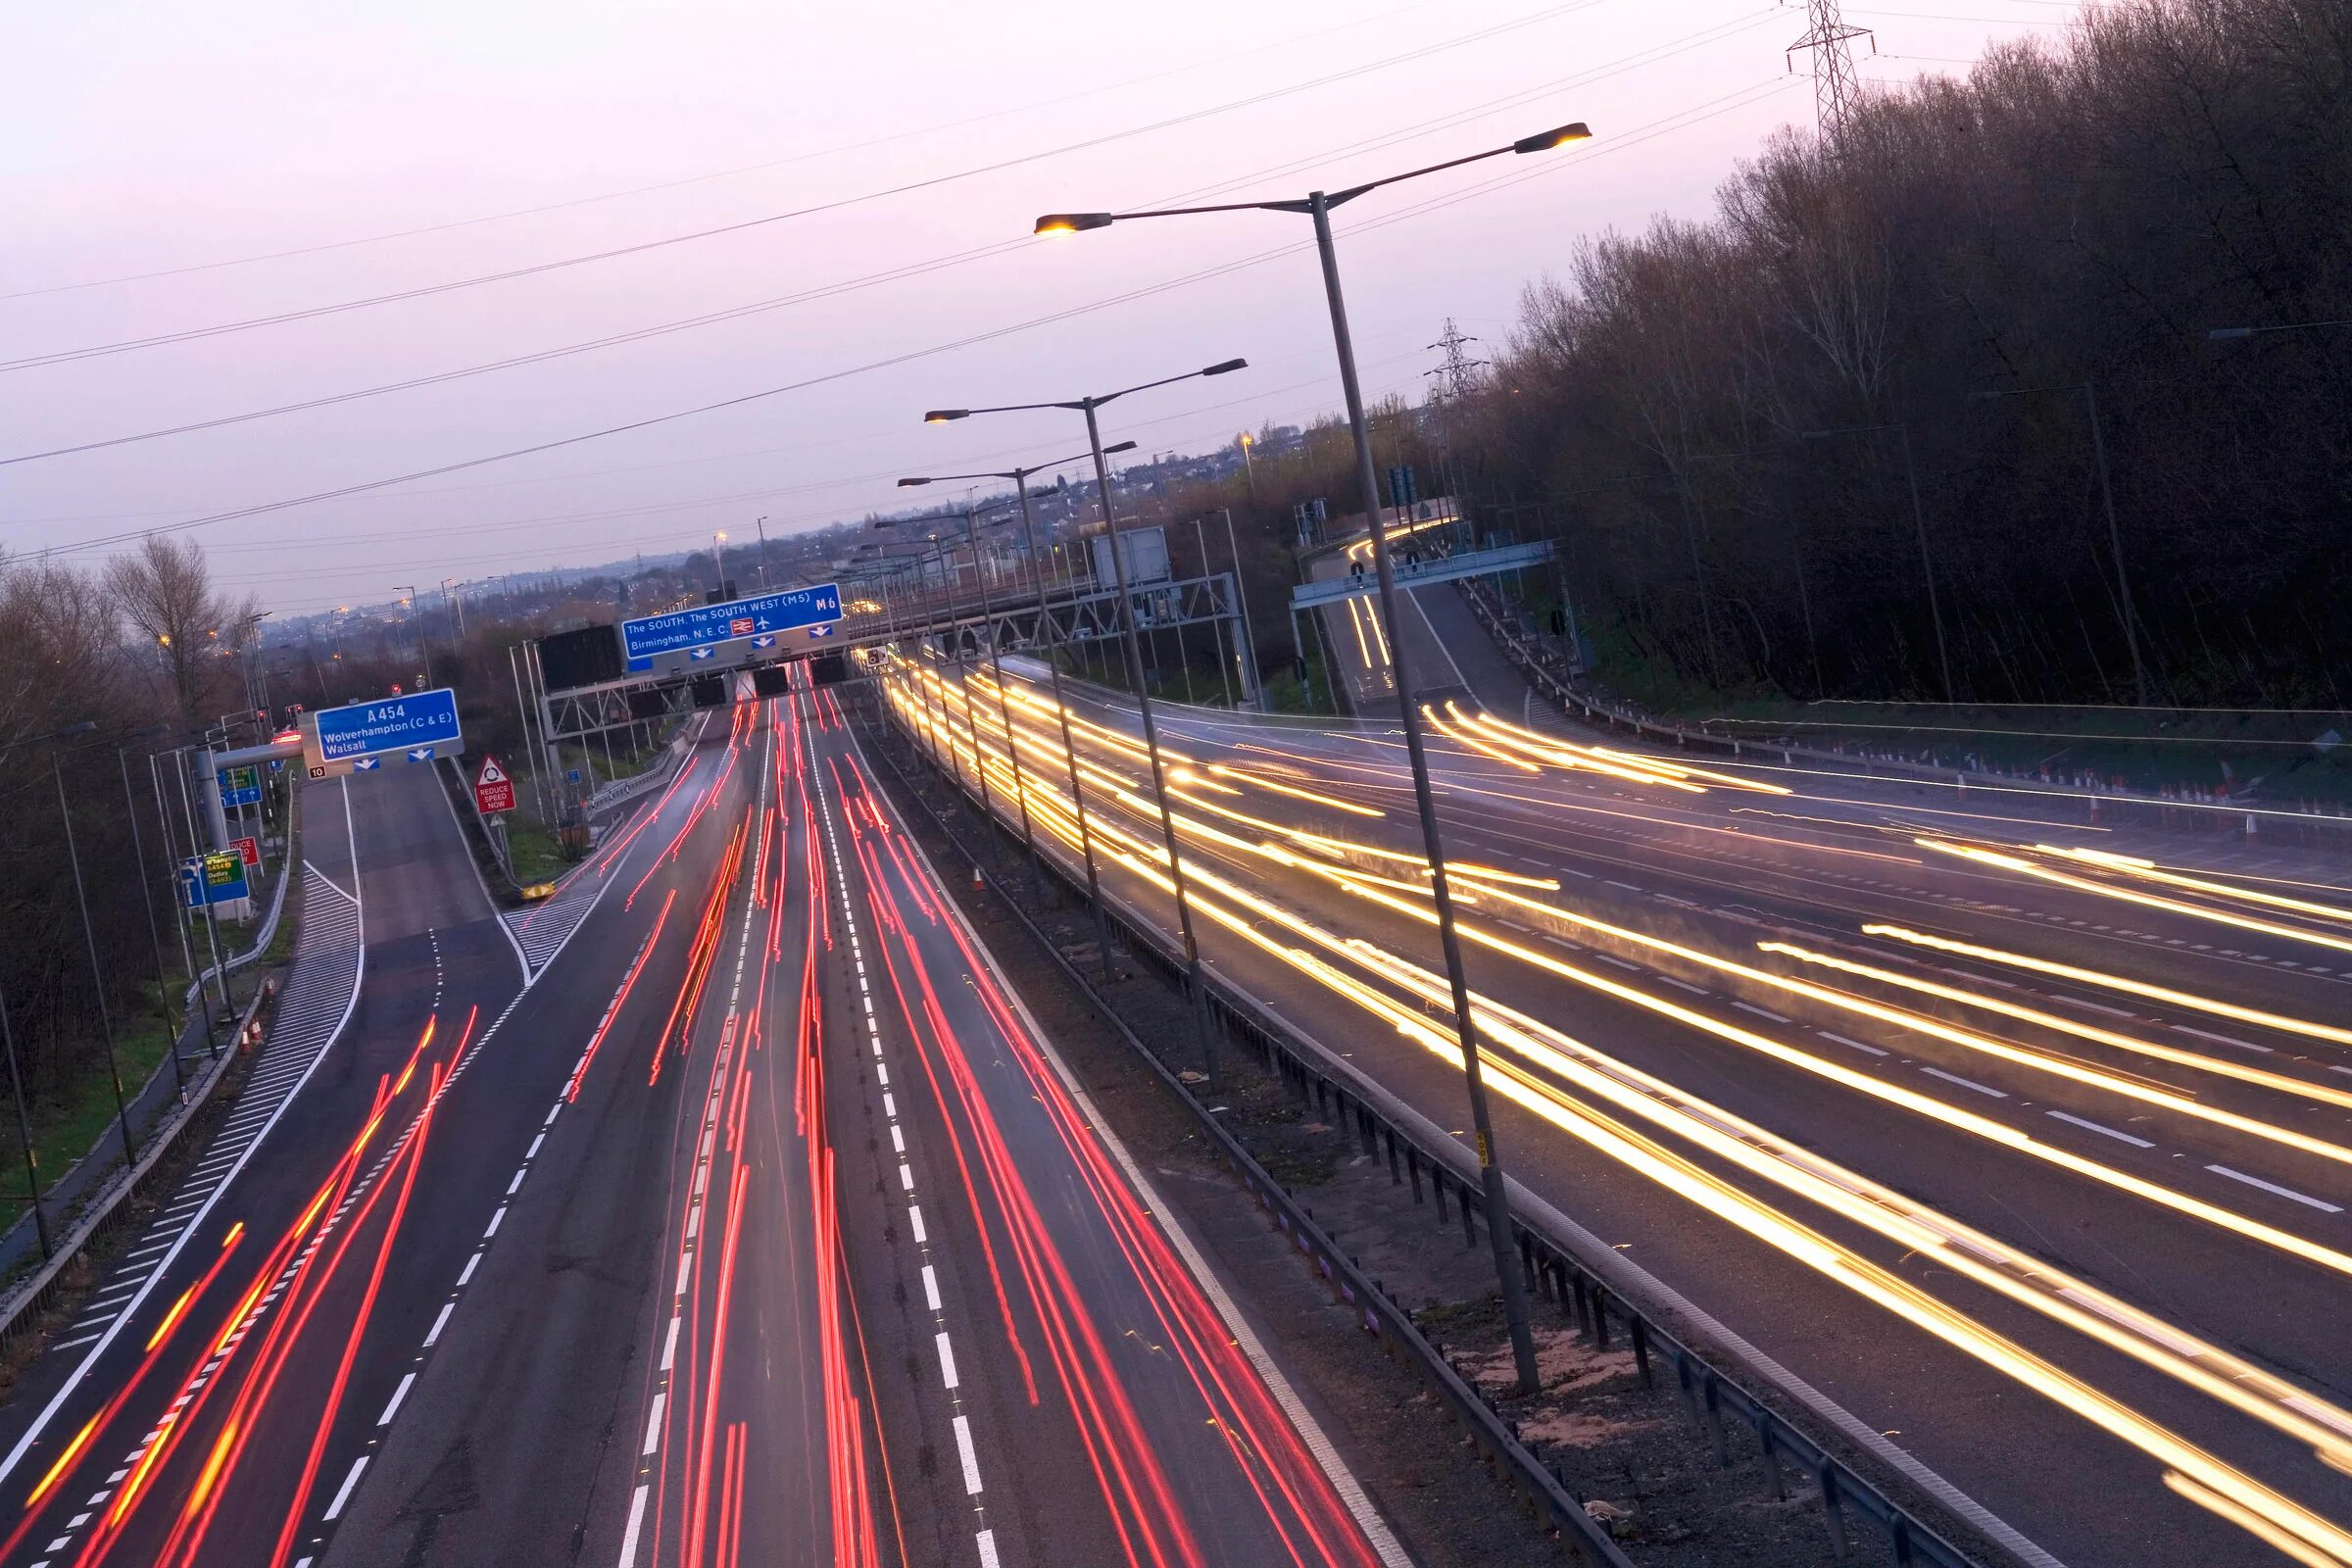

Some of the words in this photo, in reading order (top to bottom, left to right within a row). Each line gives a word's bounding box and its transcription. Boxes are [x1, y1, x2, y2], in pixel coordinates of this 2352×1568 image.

[627, 624, 646, 635] The
[689, 612, 708, 623] The
[710, 605, 748, 619] SOUTH
[749, 598, 779, 612] WEST
[782, 592, 810, 608] (M5)
[324, 722, 408, 745] Wolverhampton
[427, 715, 436, 725] &
[326, 740, 367, 756] Walsall
[312, 767, 322, 778] 10
[480, 785, 509, 796] REDUCE
[484, 793, 508, 803] SPEED
[487, 801, 506, 809] NOW
